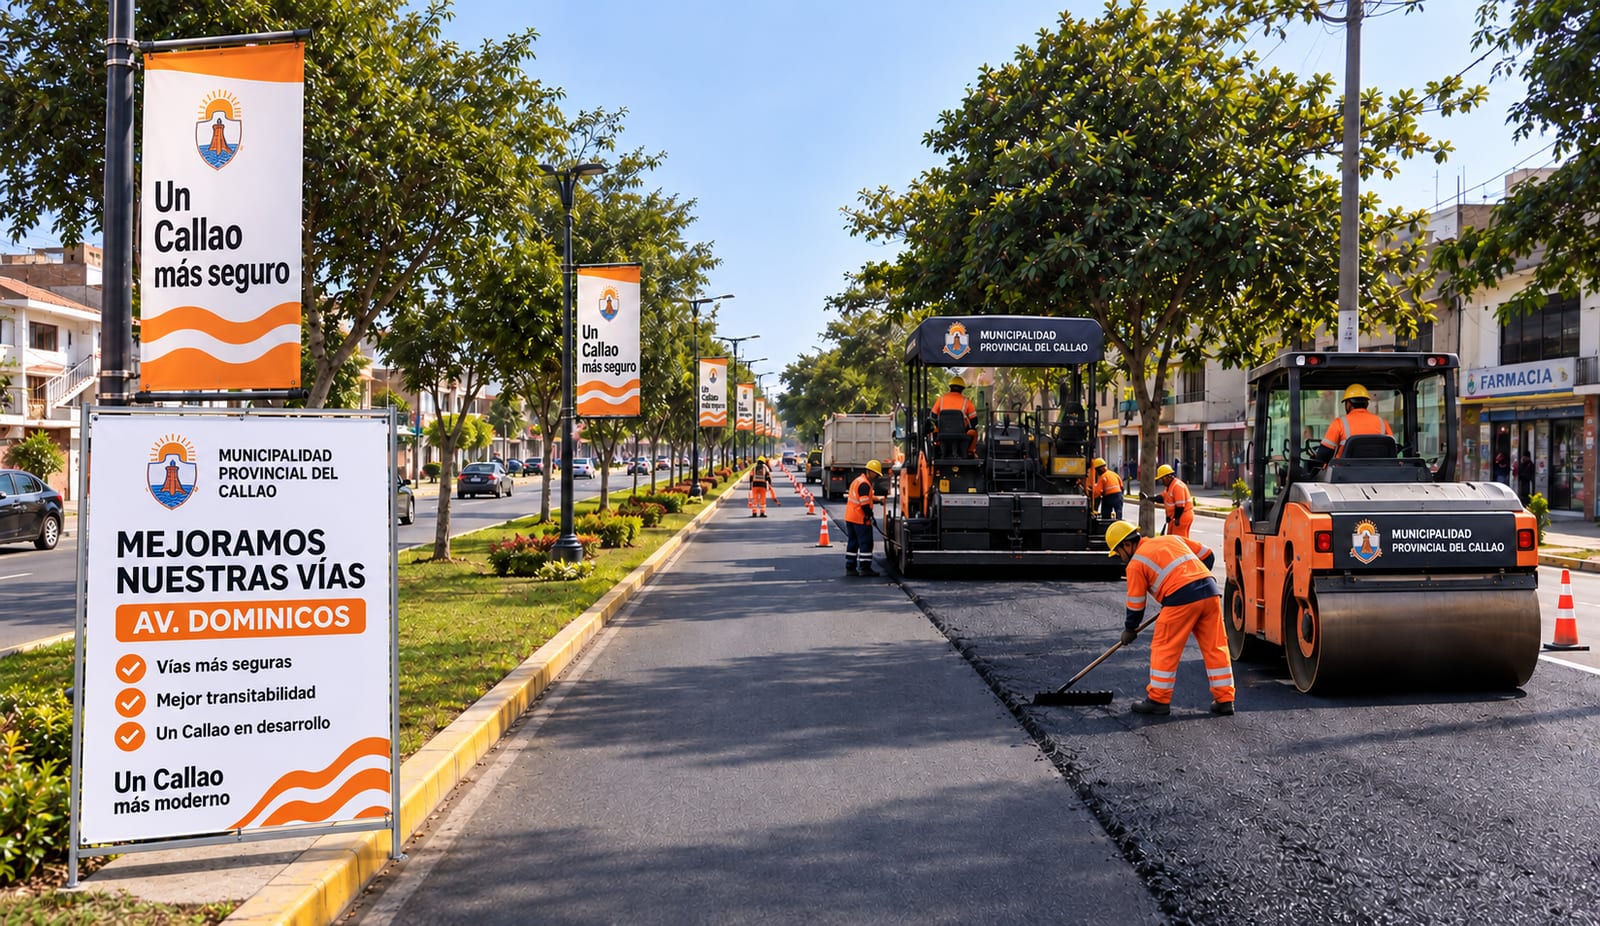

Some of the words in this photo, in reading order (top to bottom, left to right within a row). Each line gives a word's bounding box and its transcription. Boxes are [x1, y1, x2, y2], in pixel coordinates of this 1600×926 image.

[155, 180, 190, 212] Un
[155, 217, 242, 252] Callao
[155, 258, 202, 288] más
[208, 262, 289, 293] seguro
[583, 325, 598, 339] Un
[981, 331, 1056, 339] MUNICIPALIDAD
[583, 342, 618, 357] Callao
[981, 343, 1032, 351] PROVINCIAL
[1035, 343, 1051, 351] DEL
[1054, 343, 1088, 351] CALLAO
[583, 359, 602, 373] más
[604, 363, 636, 376] seguro
[1480, 368, 1553, 391] FARMACIA
[219, 449, 332, 462] MUNICIPALIDAD
[219, 467, 307, 479] PROVINCIAL
[312, 467, 338, 479] DEL
[219, 485, 276, 497] CALLAO
[118, 529, 326, 557] MEJORAMOS
[1392, 529, 1471, 539] MUNICIPALIDAD
[1393, 543, 1447, 552] PROVINCIAL
[1450, 543, 1466, 552] DEL
[1469, 543, 1504, 552] CALLAO
[117, 564, 288, 593] NUESTRAS
[298, 557, 365, 589] VÍAS
[133, 611, 178, 634] AV.
[190, 606, 349, 632] DOMINICOS
[157, 659, 190, 673] Vías
[196, 657, 227, 672] más
[233, 658, 291, 673] seguras
[157, 692, 202, 709] Mejor
[206, 685, 315, 704] transitabilidad
[157, 726, 177, 740] Un
[183, 723, 230, 738] Callao
[234, 724, 252, 735] en
[257, 716, 330, 733] desarrollo
[115, 771, 145, 793] Un
[154, 766, 223, 790] Callao
[114, 797, 149, 815] más
[155, 792, 229, 811] moderno
